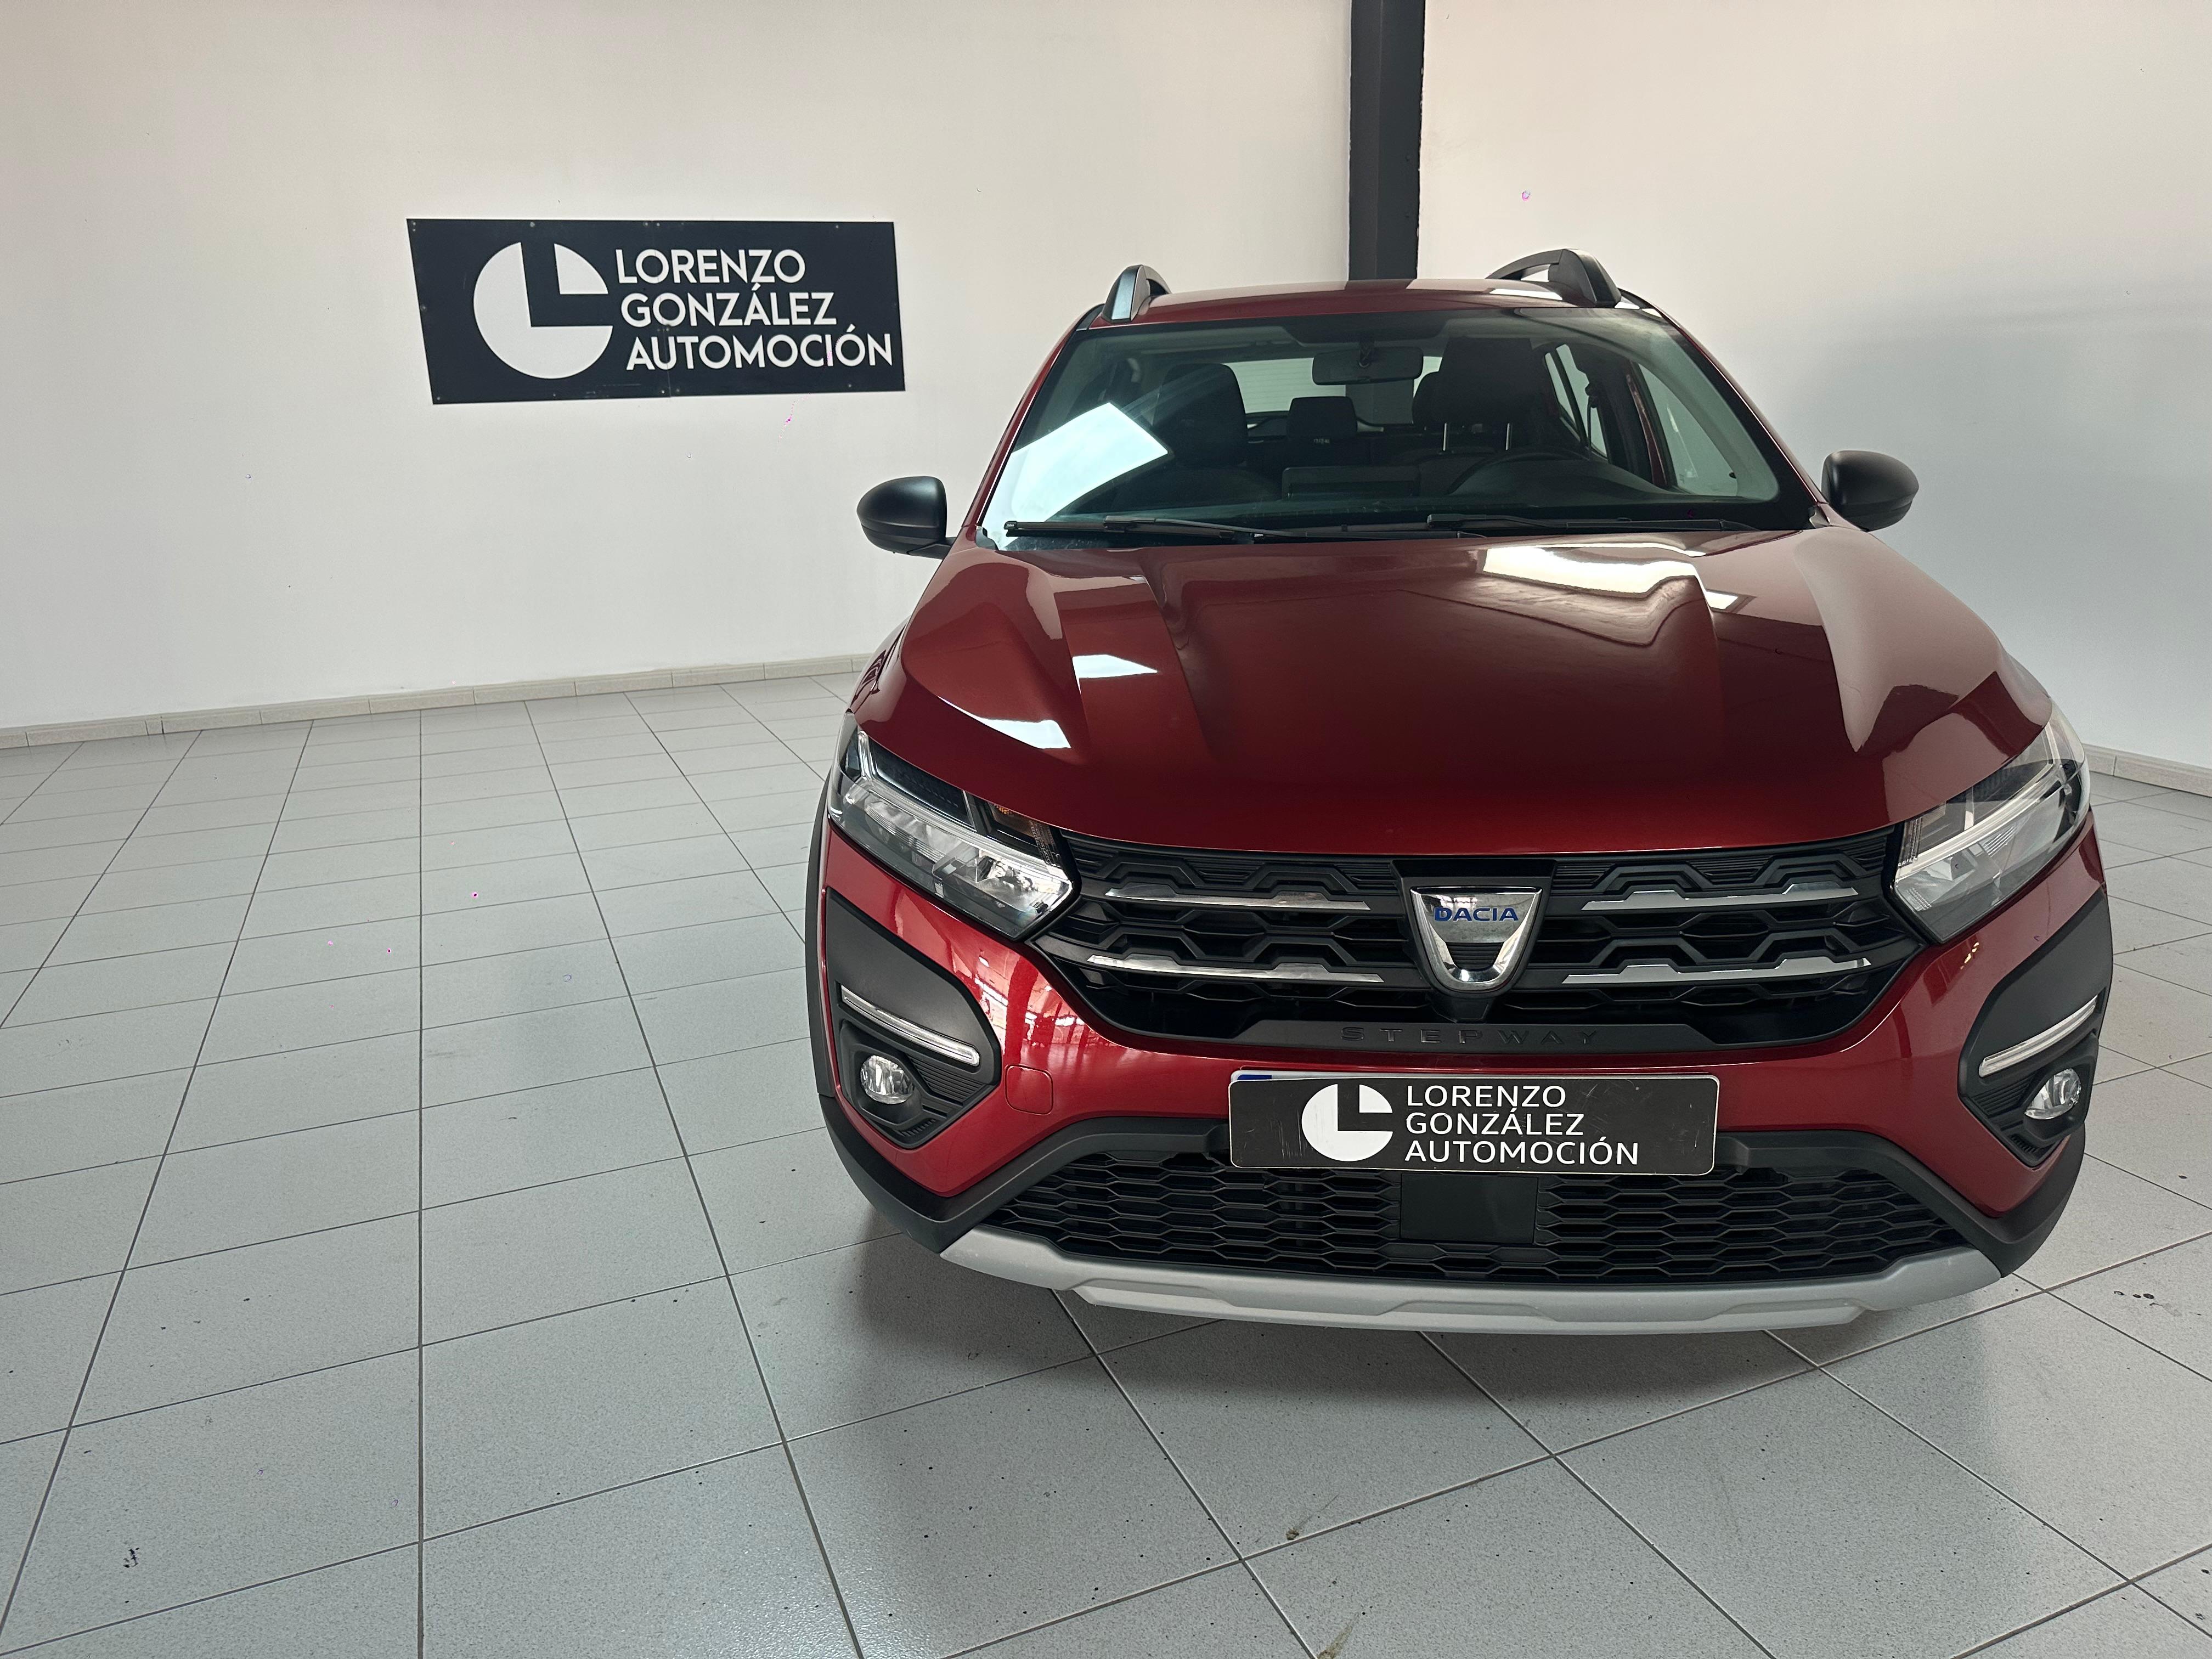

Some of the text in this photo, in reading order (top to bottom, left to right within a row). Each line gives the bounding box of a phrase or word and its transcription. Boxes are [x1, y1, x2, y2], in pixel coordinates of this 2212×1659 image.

[615, 249, 805, 284] LORENZO
[621, 282, 837, 328] GONZÁLEZ
[626, 324, 893, 371] AUTOMOCIÓN
[1434, 907, 1519, 922] DACIA
[1340, 1026, 1597, 1045] STEPWAY
[1407, 1085, 1566, 1108] LORENZO
[1405, 1107, 1584, 1136] GONZÁLEZ
[1404, 1136, 1639, 1165] AUTOMOCIÓN
